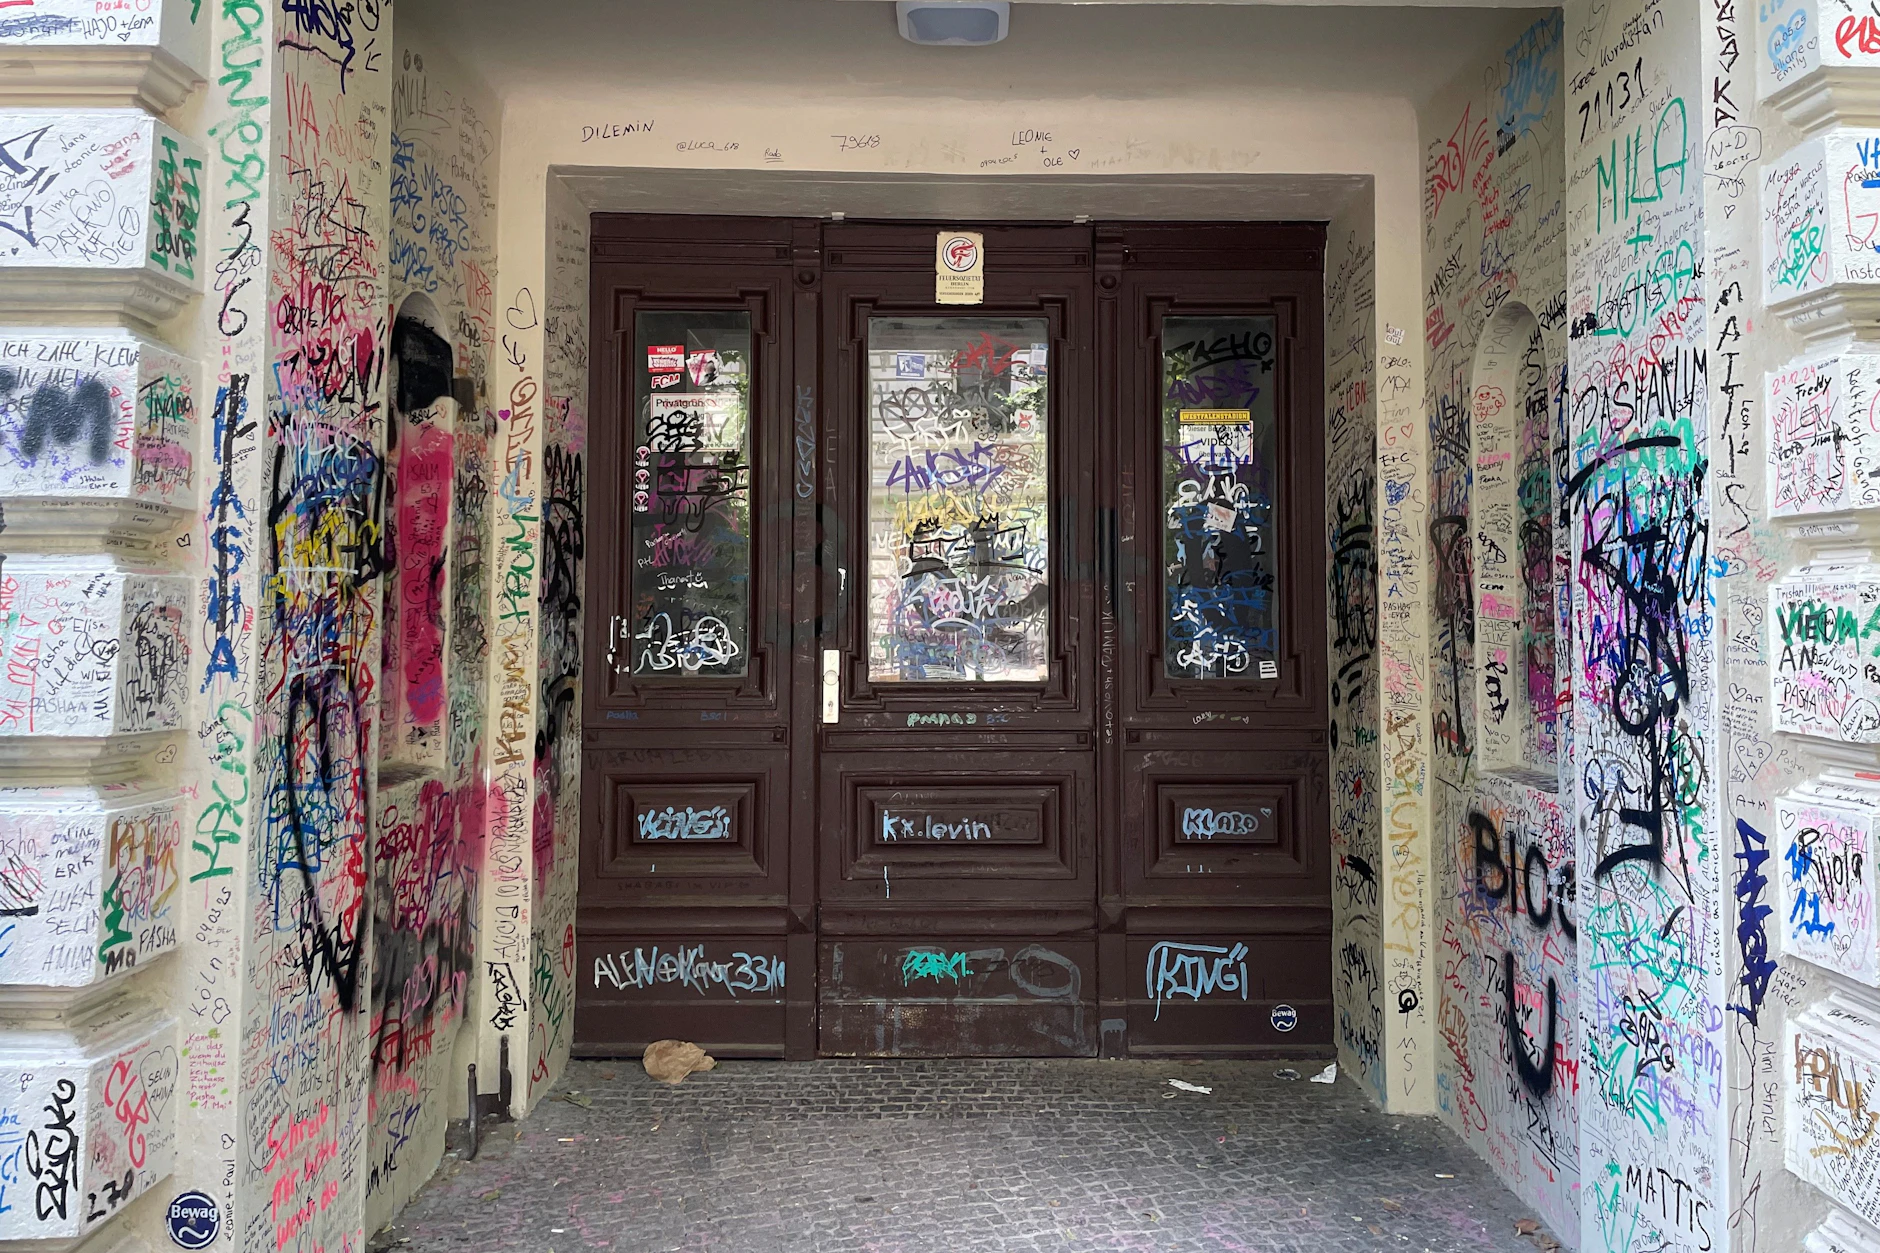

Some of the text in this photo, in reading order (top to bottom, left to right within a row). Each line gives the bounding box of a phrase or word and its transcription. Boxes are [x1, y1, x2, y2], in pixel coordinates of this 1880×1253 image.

[652, 374, 681, 389] FCM
[113, 399, 135, 450] Aylin
[55, 855, 94, 879] ERIK
[171, 1204, 219, 1224] Bewag
[1626, 1163, 1712, 1252] MATTIS
